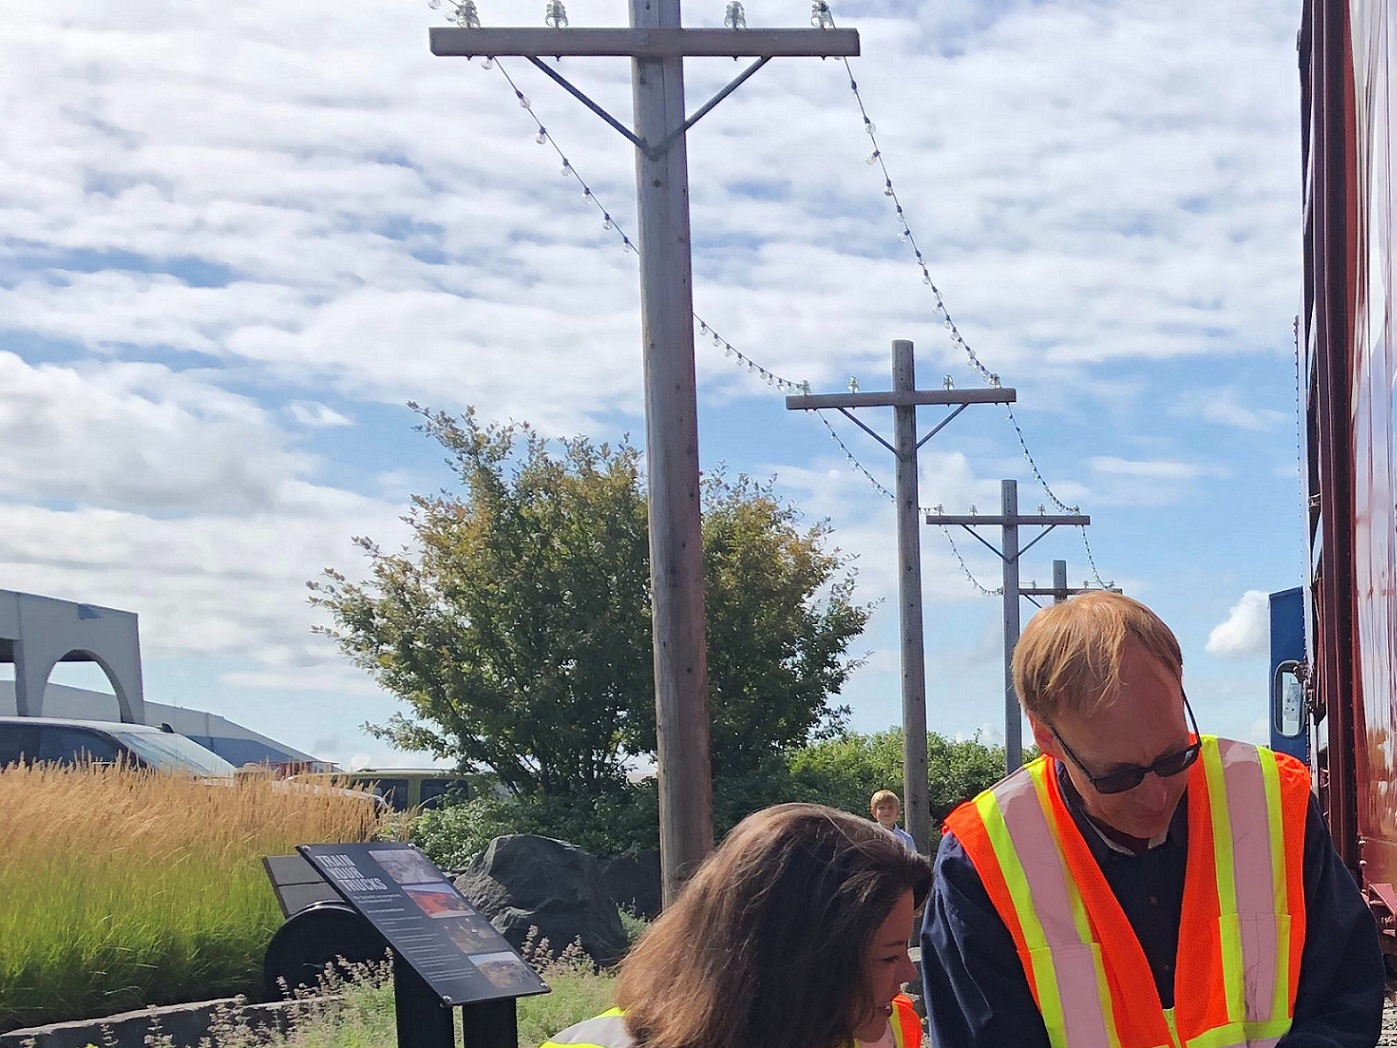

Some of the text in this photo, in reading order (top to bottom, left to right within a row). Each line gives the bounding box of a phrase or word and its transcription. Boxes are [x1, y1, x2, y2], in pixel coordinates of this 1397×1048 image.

[315, 854, 356, 867] TRAIN
[326, 866, 364, 879] YOUR
[338, 877, 388, 891] TRUCKS
